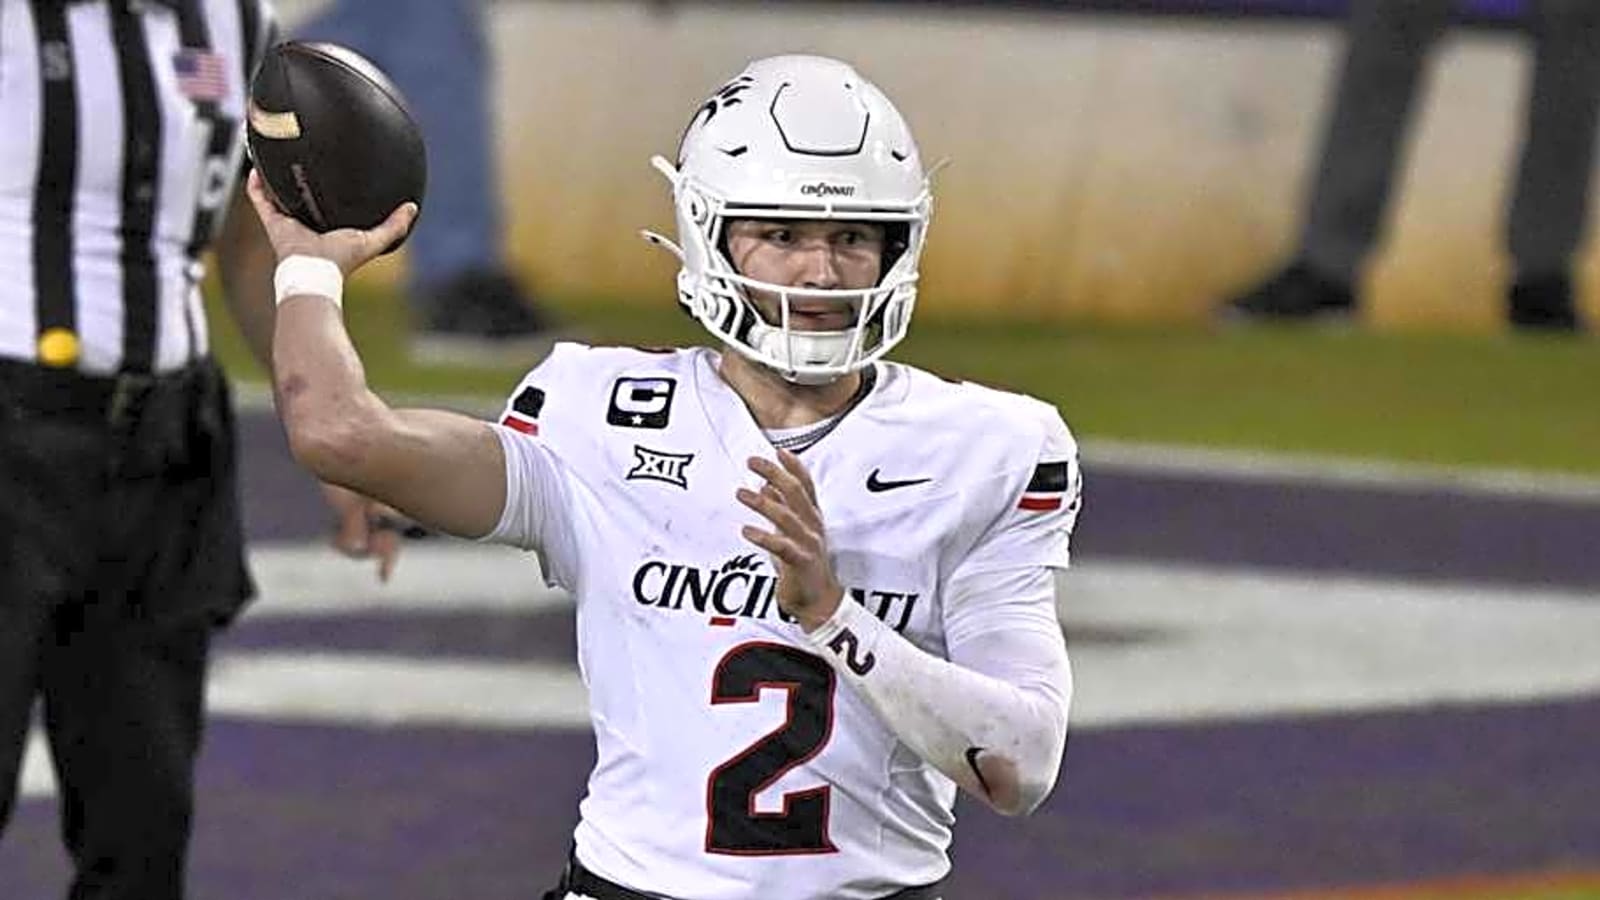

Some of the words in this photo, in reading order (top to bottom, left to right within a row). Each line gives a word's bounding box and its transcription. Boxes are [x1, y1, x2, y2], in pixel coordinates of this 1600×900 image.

[800, 182, 855, 197] CINCINNATI
[614, 380, 671, 413] C
[629, 447, 692, 486] XII
[632, 555, 919, 633] CINCITI
[827, 627, 876, 676] 2
[705, 640, 840, 856] 2
